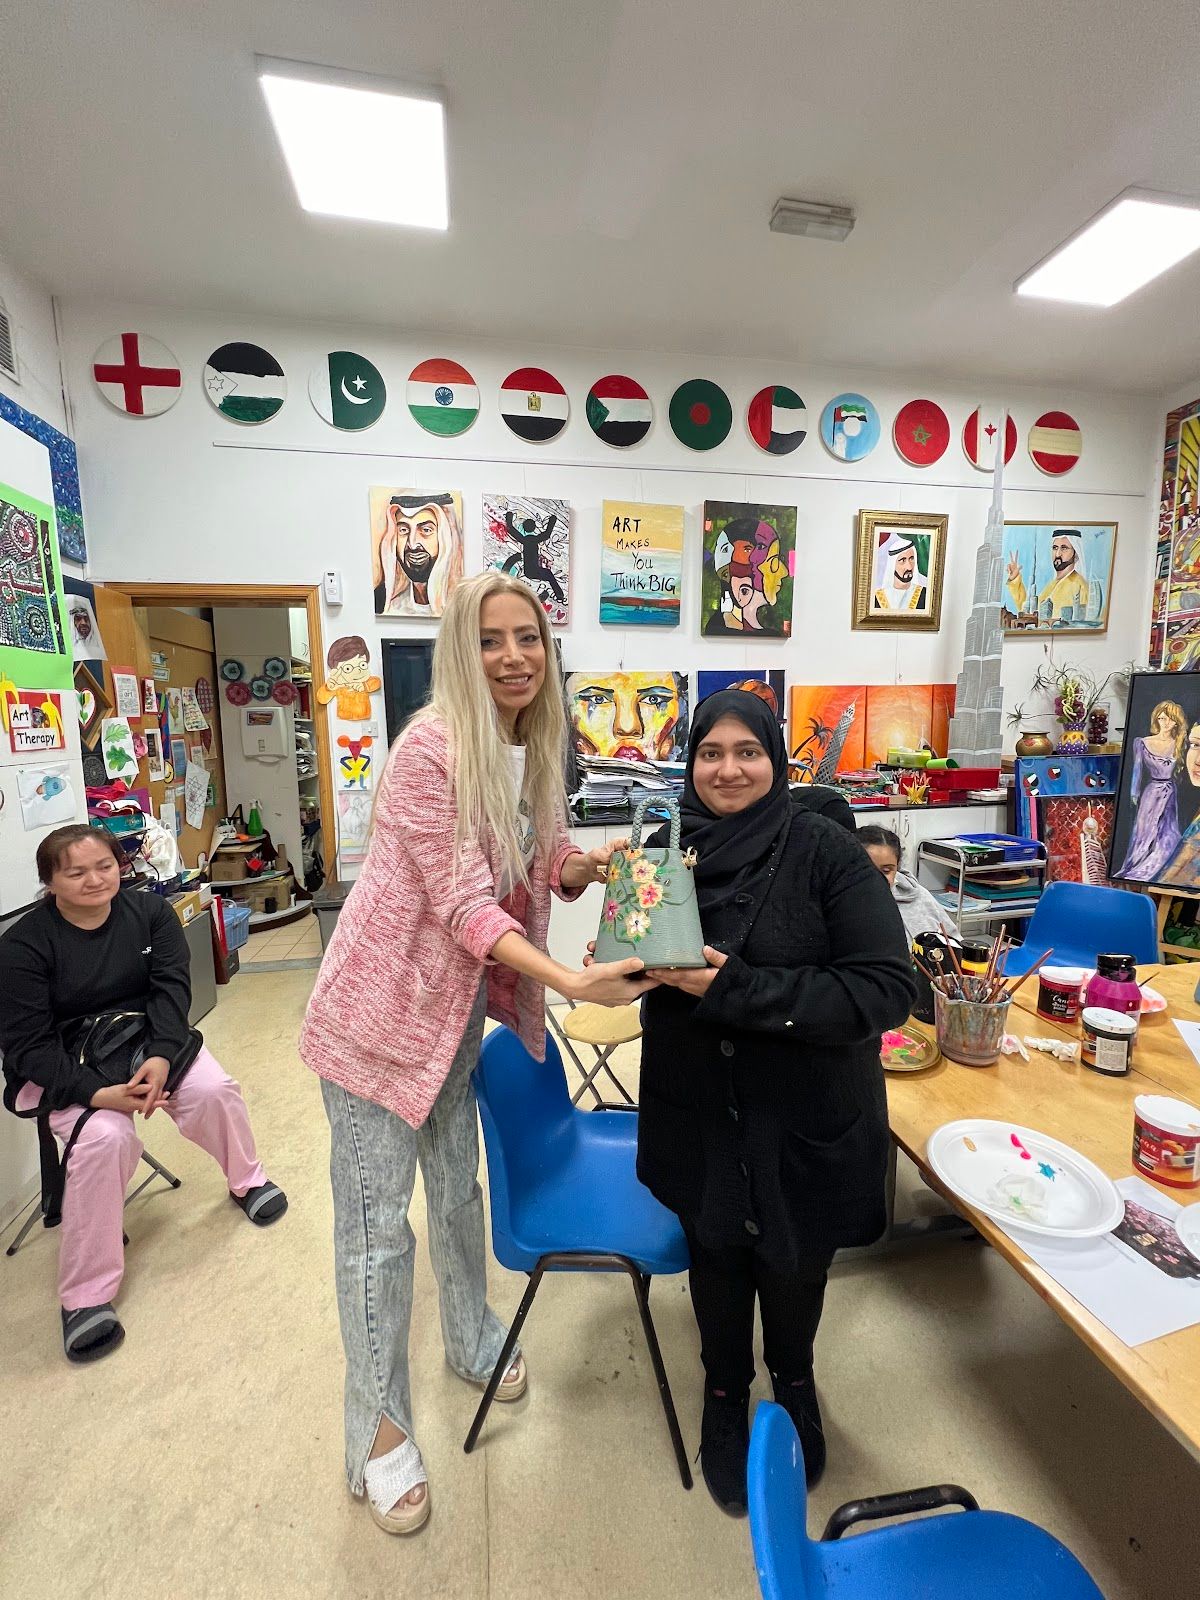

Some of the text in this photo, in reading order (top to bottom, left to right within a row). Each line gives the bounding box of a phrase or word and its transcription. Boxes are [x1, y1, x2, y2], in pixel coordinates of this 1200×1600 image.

[612, 516, 641, 533] ART
[616, 538, 650, 550] MAKES
[610, 572, 676, 594] Think BIG
[12, 709, 29, 721] Art
[17, 732, 55, 746] Therapy
